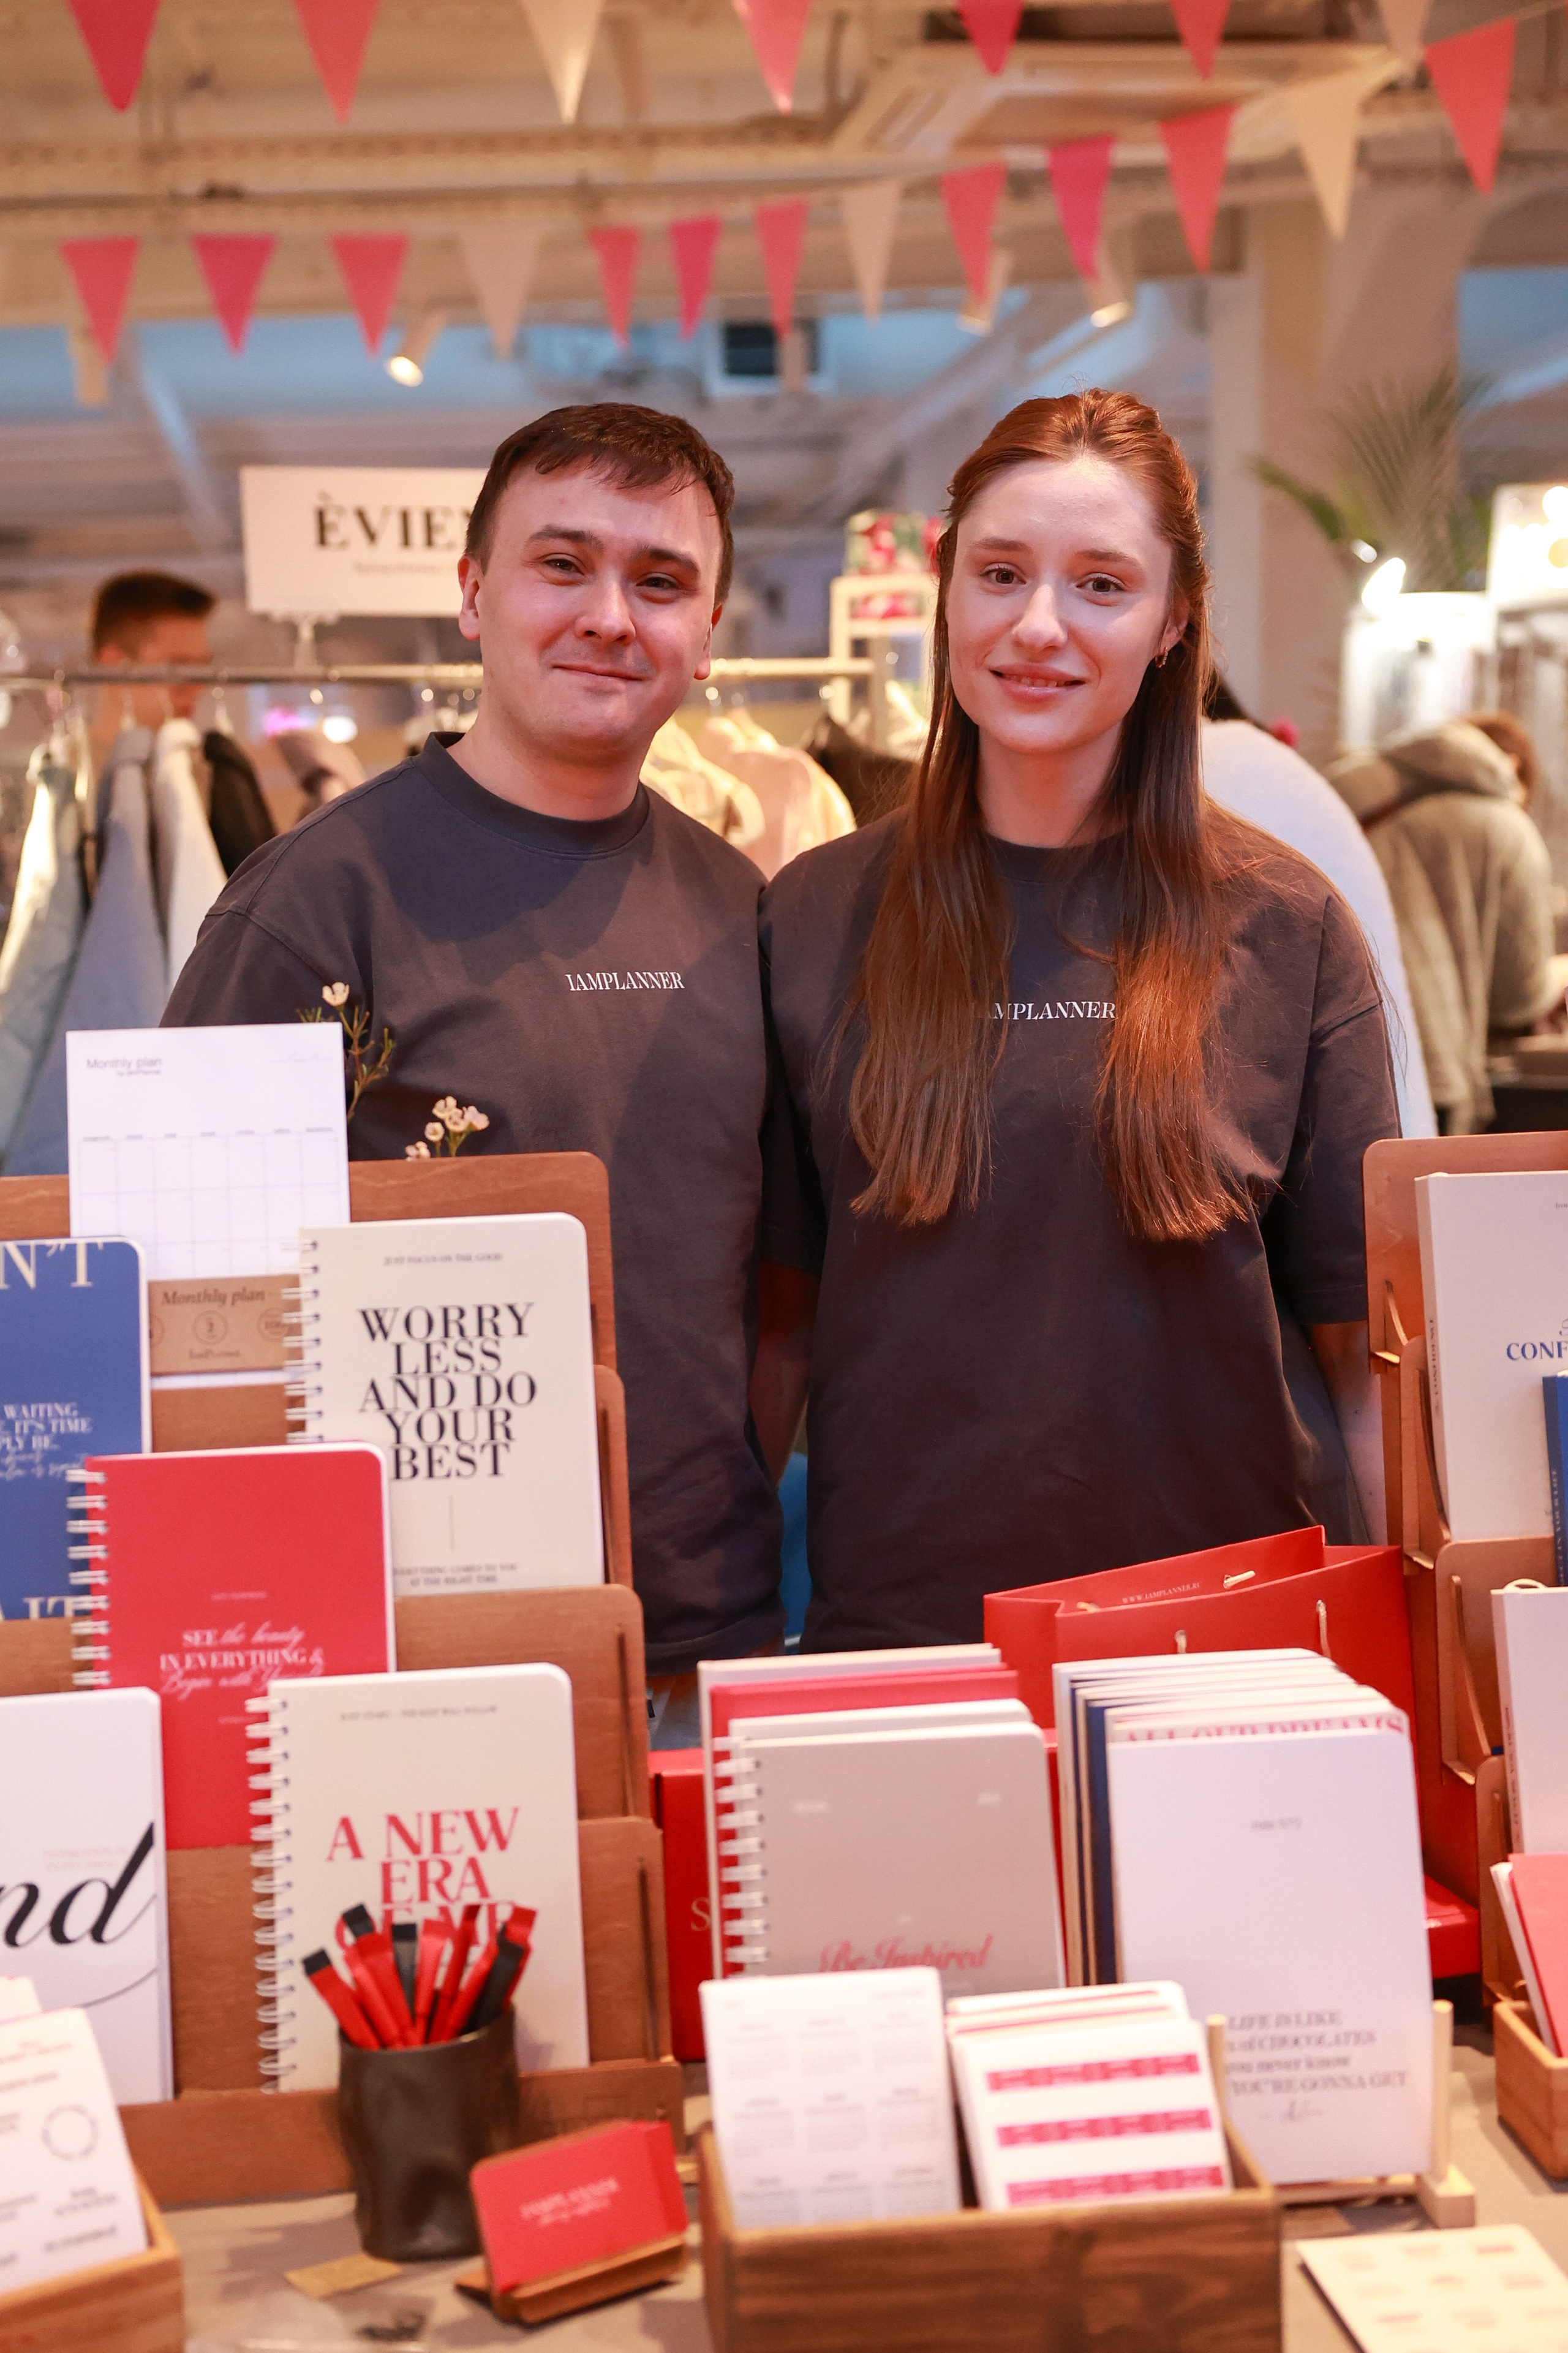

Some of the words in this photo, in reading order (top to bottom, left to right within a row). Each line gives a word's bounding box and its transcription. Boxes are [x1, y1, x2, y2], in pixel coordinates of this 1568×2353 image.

[315, 491, 472, 550] ÈVIE
[565, 971, 685, 991] IAMPLANNER
[993, 1000, 1117, 1020] MPLANNER
[86, 1058, 131, 1070] Monthly
[136, 1057, 163, 1068] plan
[161, 1288, 227, 1309] Monthly
[230, 1287, 266, 1306] plan
[356, 1301, 535, 1342] WORRY
[390, 1337, 502, 1376] LESS
[359, 1373, 456, 1413] AND
[473, 1370, 537, 1407] DO
[385, 1407, 514, 1446] YOUR
[390, 1440, 511, 1481] BEST
[326, 1815, 364, 1862] A
[384, 1805, 520, 1858] NEW
[380, 1856, 491, 1905] ERA
